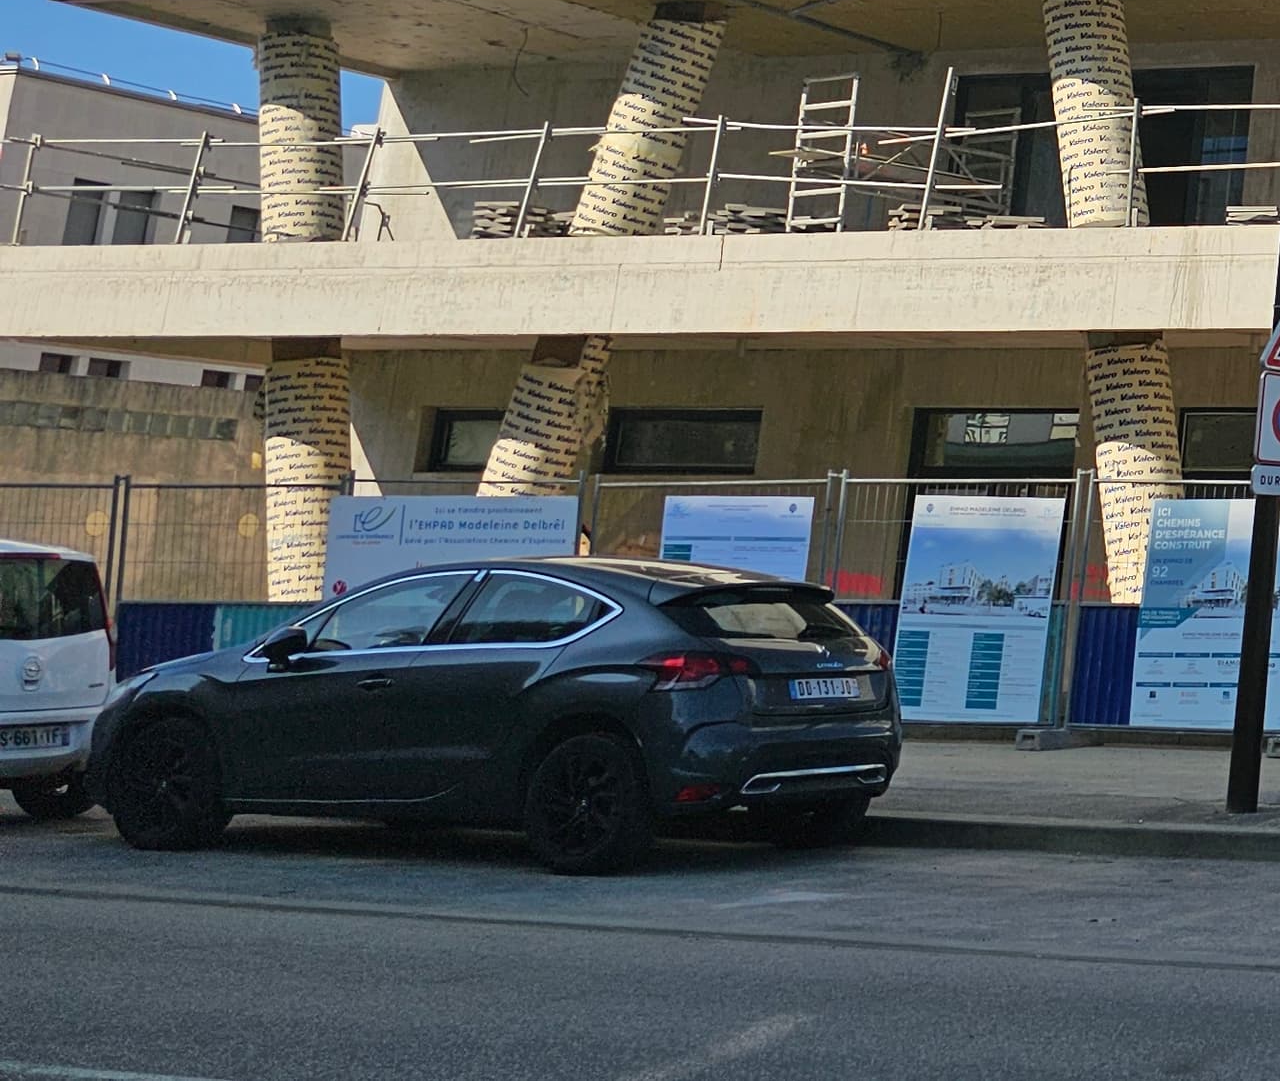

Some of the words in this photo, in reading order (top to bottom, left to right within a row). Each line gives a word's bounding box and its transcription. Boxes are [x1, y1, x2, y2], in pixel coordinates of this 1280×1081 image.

[1094, 372, 1117, 382] Valero
[1106, 383, 1132, 391] Valero
[1095, 397, 1115, 406] Valero
[1104, 433, 1129, 441] Valero
[1105, 486, 1125, 494] Valero
[1158, 507, 1171, 517] ICI
[409, 519, 454, 530] l'EHPAD
[459, 519, 518, 530] Madeleine
[1115, 522, 1139, 530] Valero
[1156, 518, 1200, 528] CHEMINS
[1155, 528, 1225, 539] D'ESPÉRANCE
[1154, 540, 1212, 550] CONSTRUIT
[1152, 565, 1168, 578] 92
[1115, 575, 1136, 583] Valero
